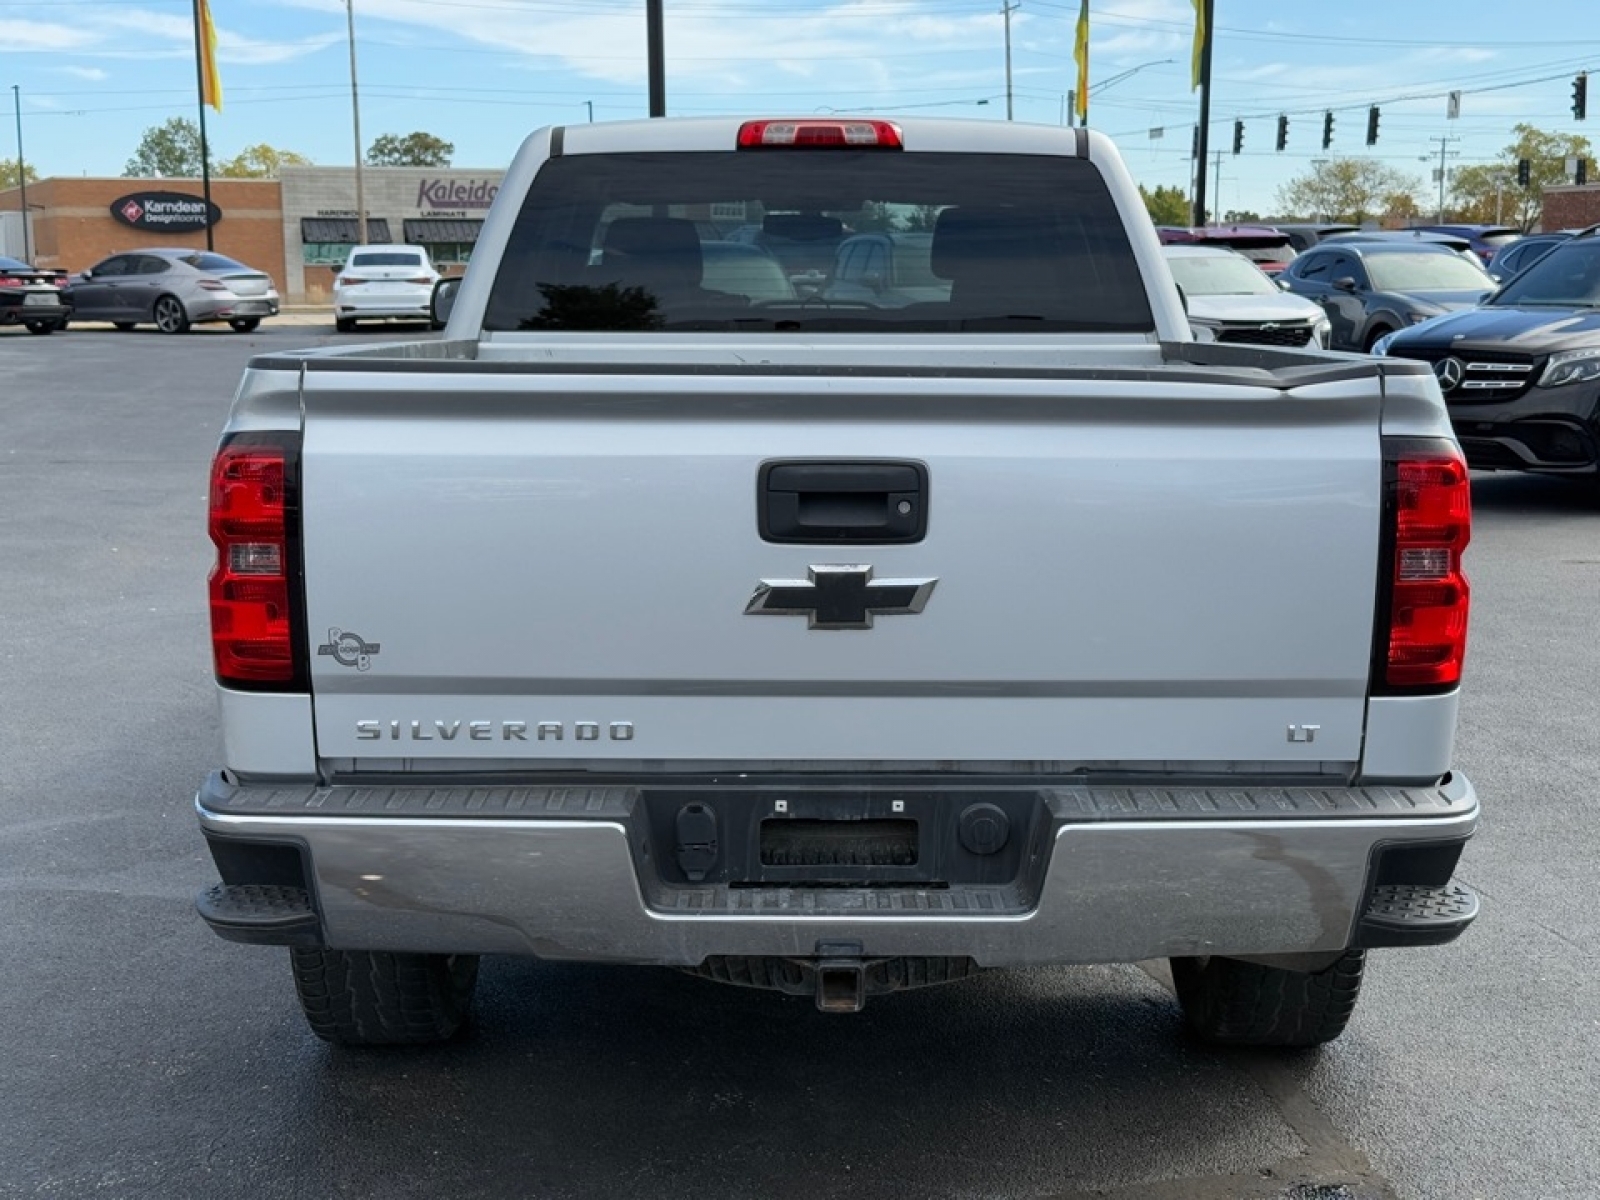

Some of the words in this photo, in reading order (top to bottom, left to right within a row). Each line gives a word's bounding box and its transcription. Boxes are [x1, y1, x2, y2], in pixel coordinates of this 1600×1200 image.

[144, 199, 206, 213] Karndean
[145, 213, 208, 224] Designflooring
[420, 210, 467, 218] LAMINATE
[356, 719, 634, 741] SILVERADO
[1286, 724, 1321, 742] LT
